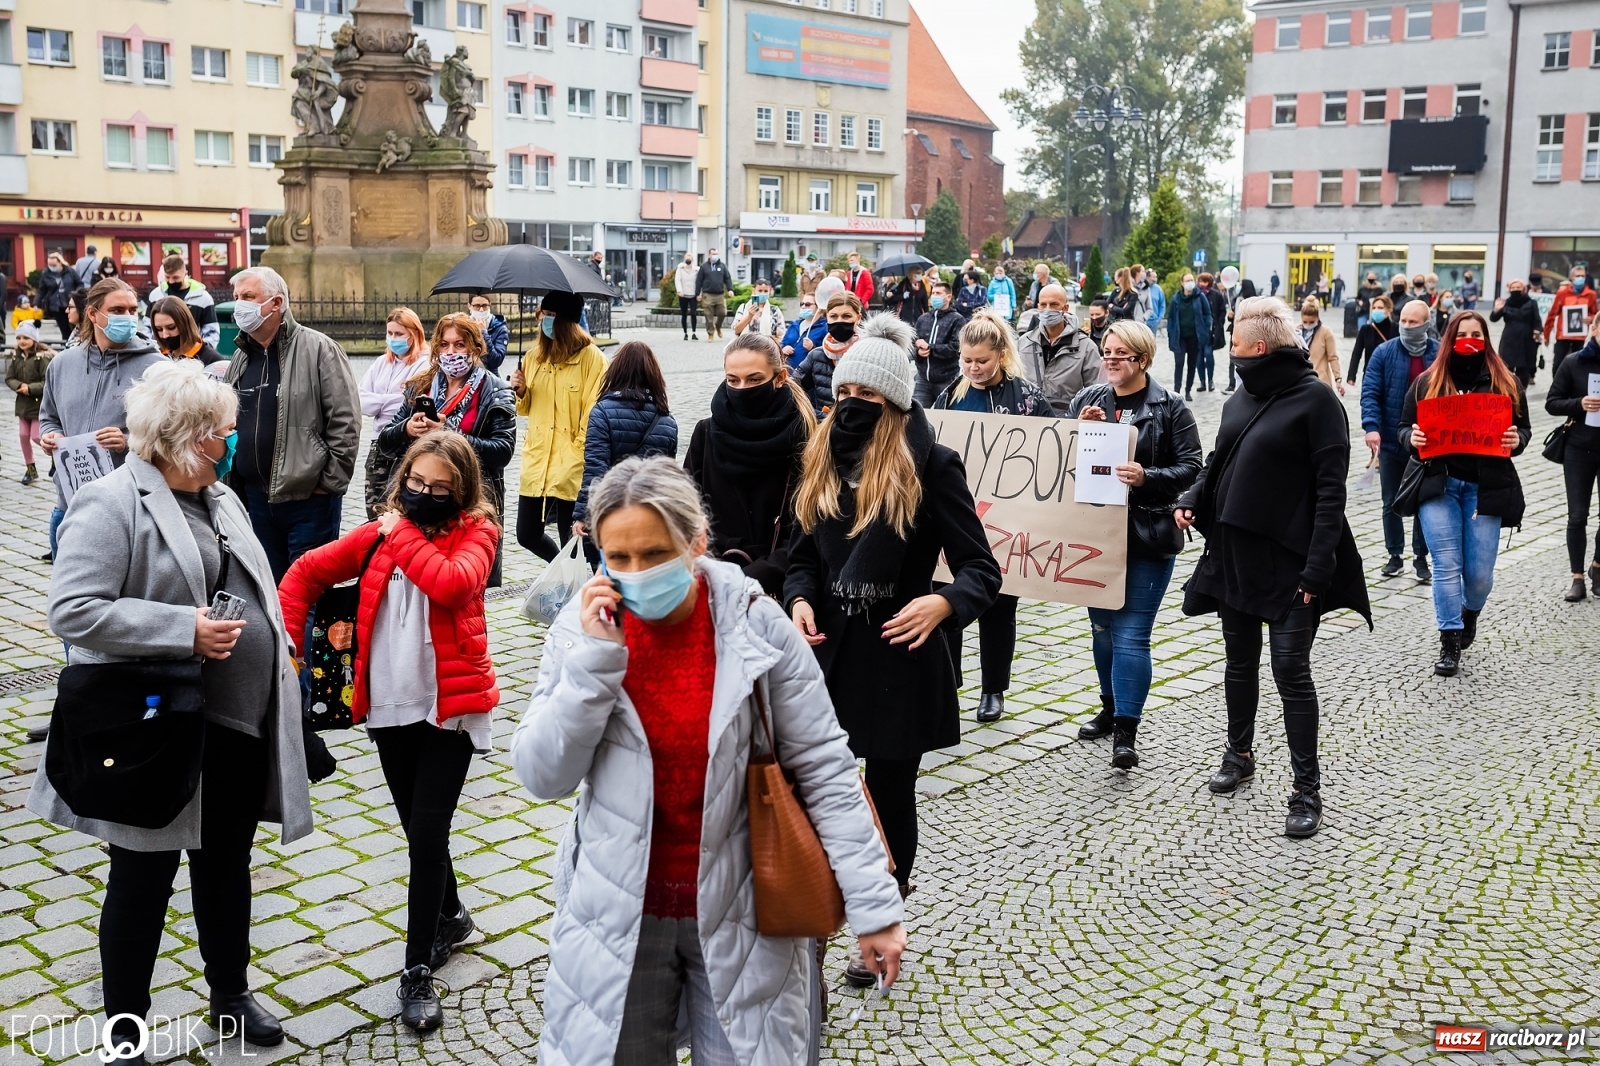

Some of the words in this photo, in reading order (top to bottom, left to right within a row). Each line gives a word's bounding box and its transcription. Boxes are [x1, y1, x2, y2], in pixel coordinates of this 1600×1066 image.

[37, 208, 143, 222] RESTAURACJA
[848, 218, 898, 230] ROSSMANN
[74, 461, 90, 469] ROK
[985, 523, 1107, 588] ZAKAZ
